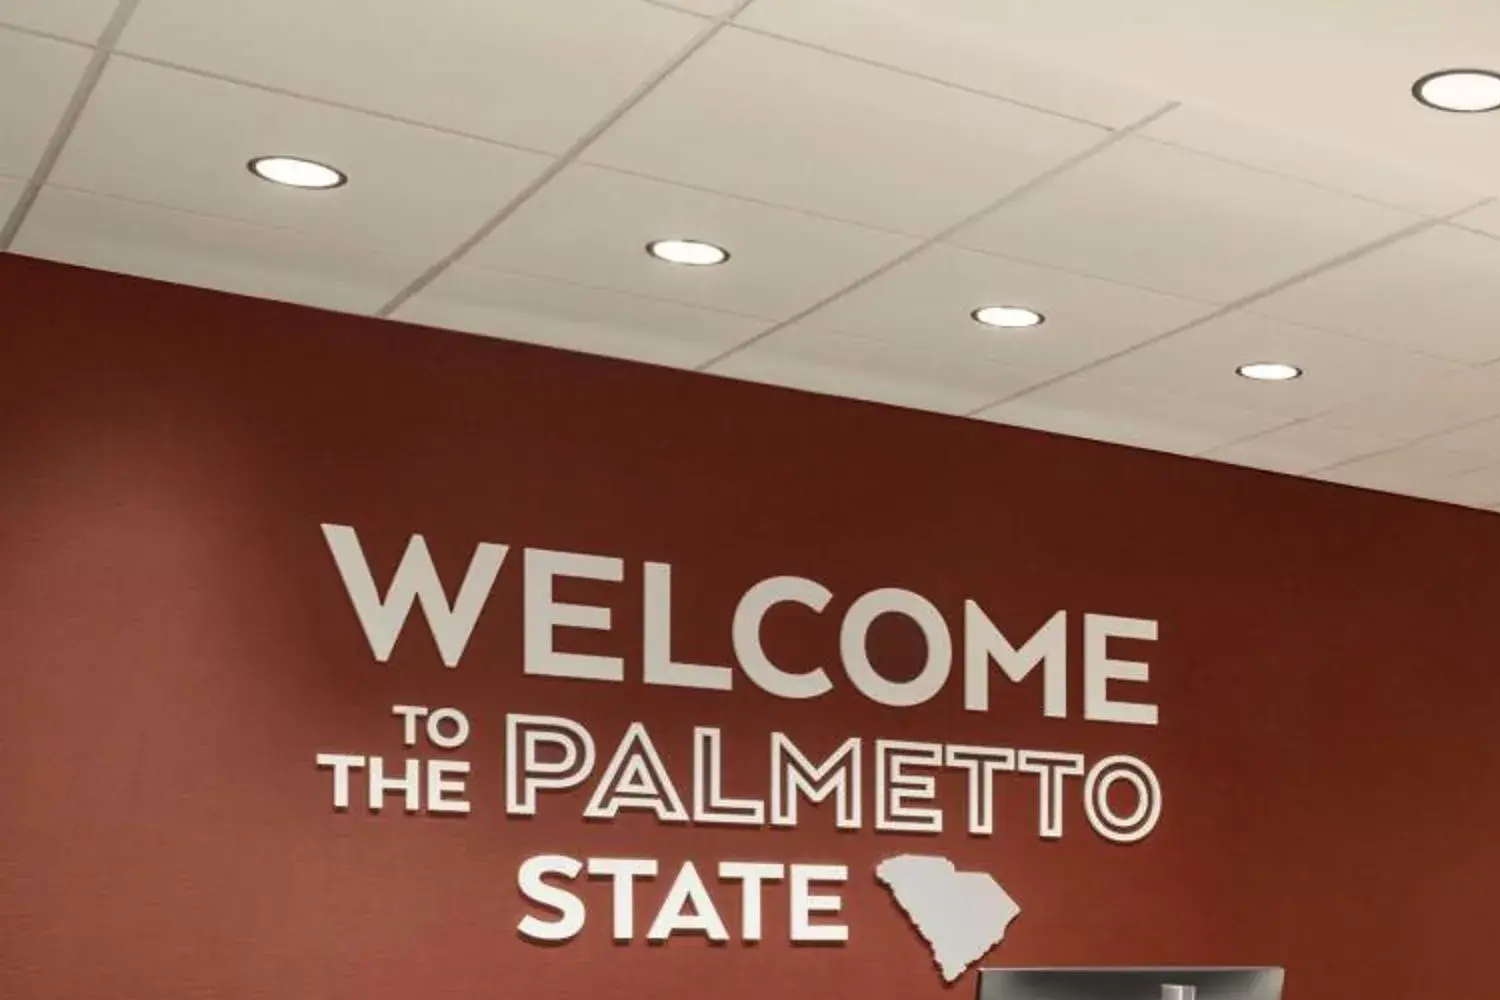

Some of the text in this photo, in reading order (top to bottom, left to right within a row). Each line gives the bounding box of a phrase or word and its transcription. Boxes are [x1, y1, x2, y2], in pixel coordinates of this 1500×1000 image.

[321, 524, 1160, 725] WELCOME
[316, 714, 1162, 842] THE PALMETTO
[393, 705, 470, 748] TO
[516, 854, 850, 941] STATE
